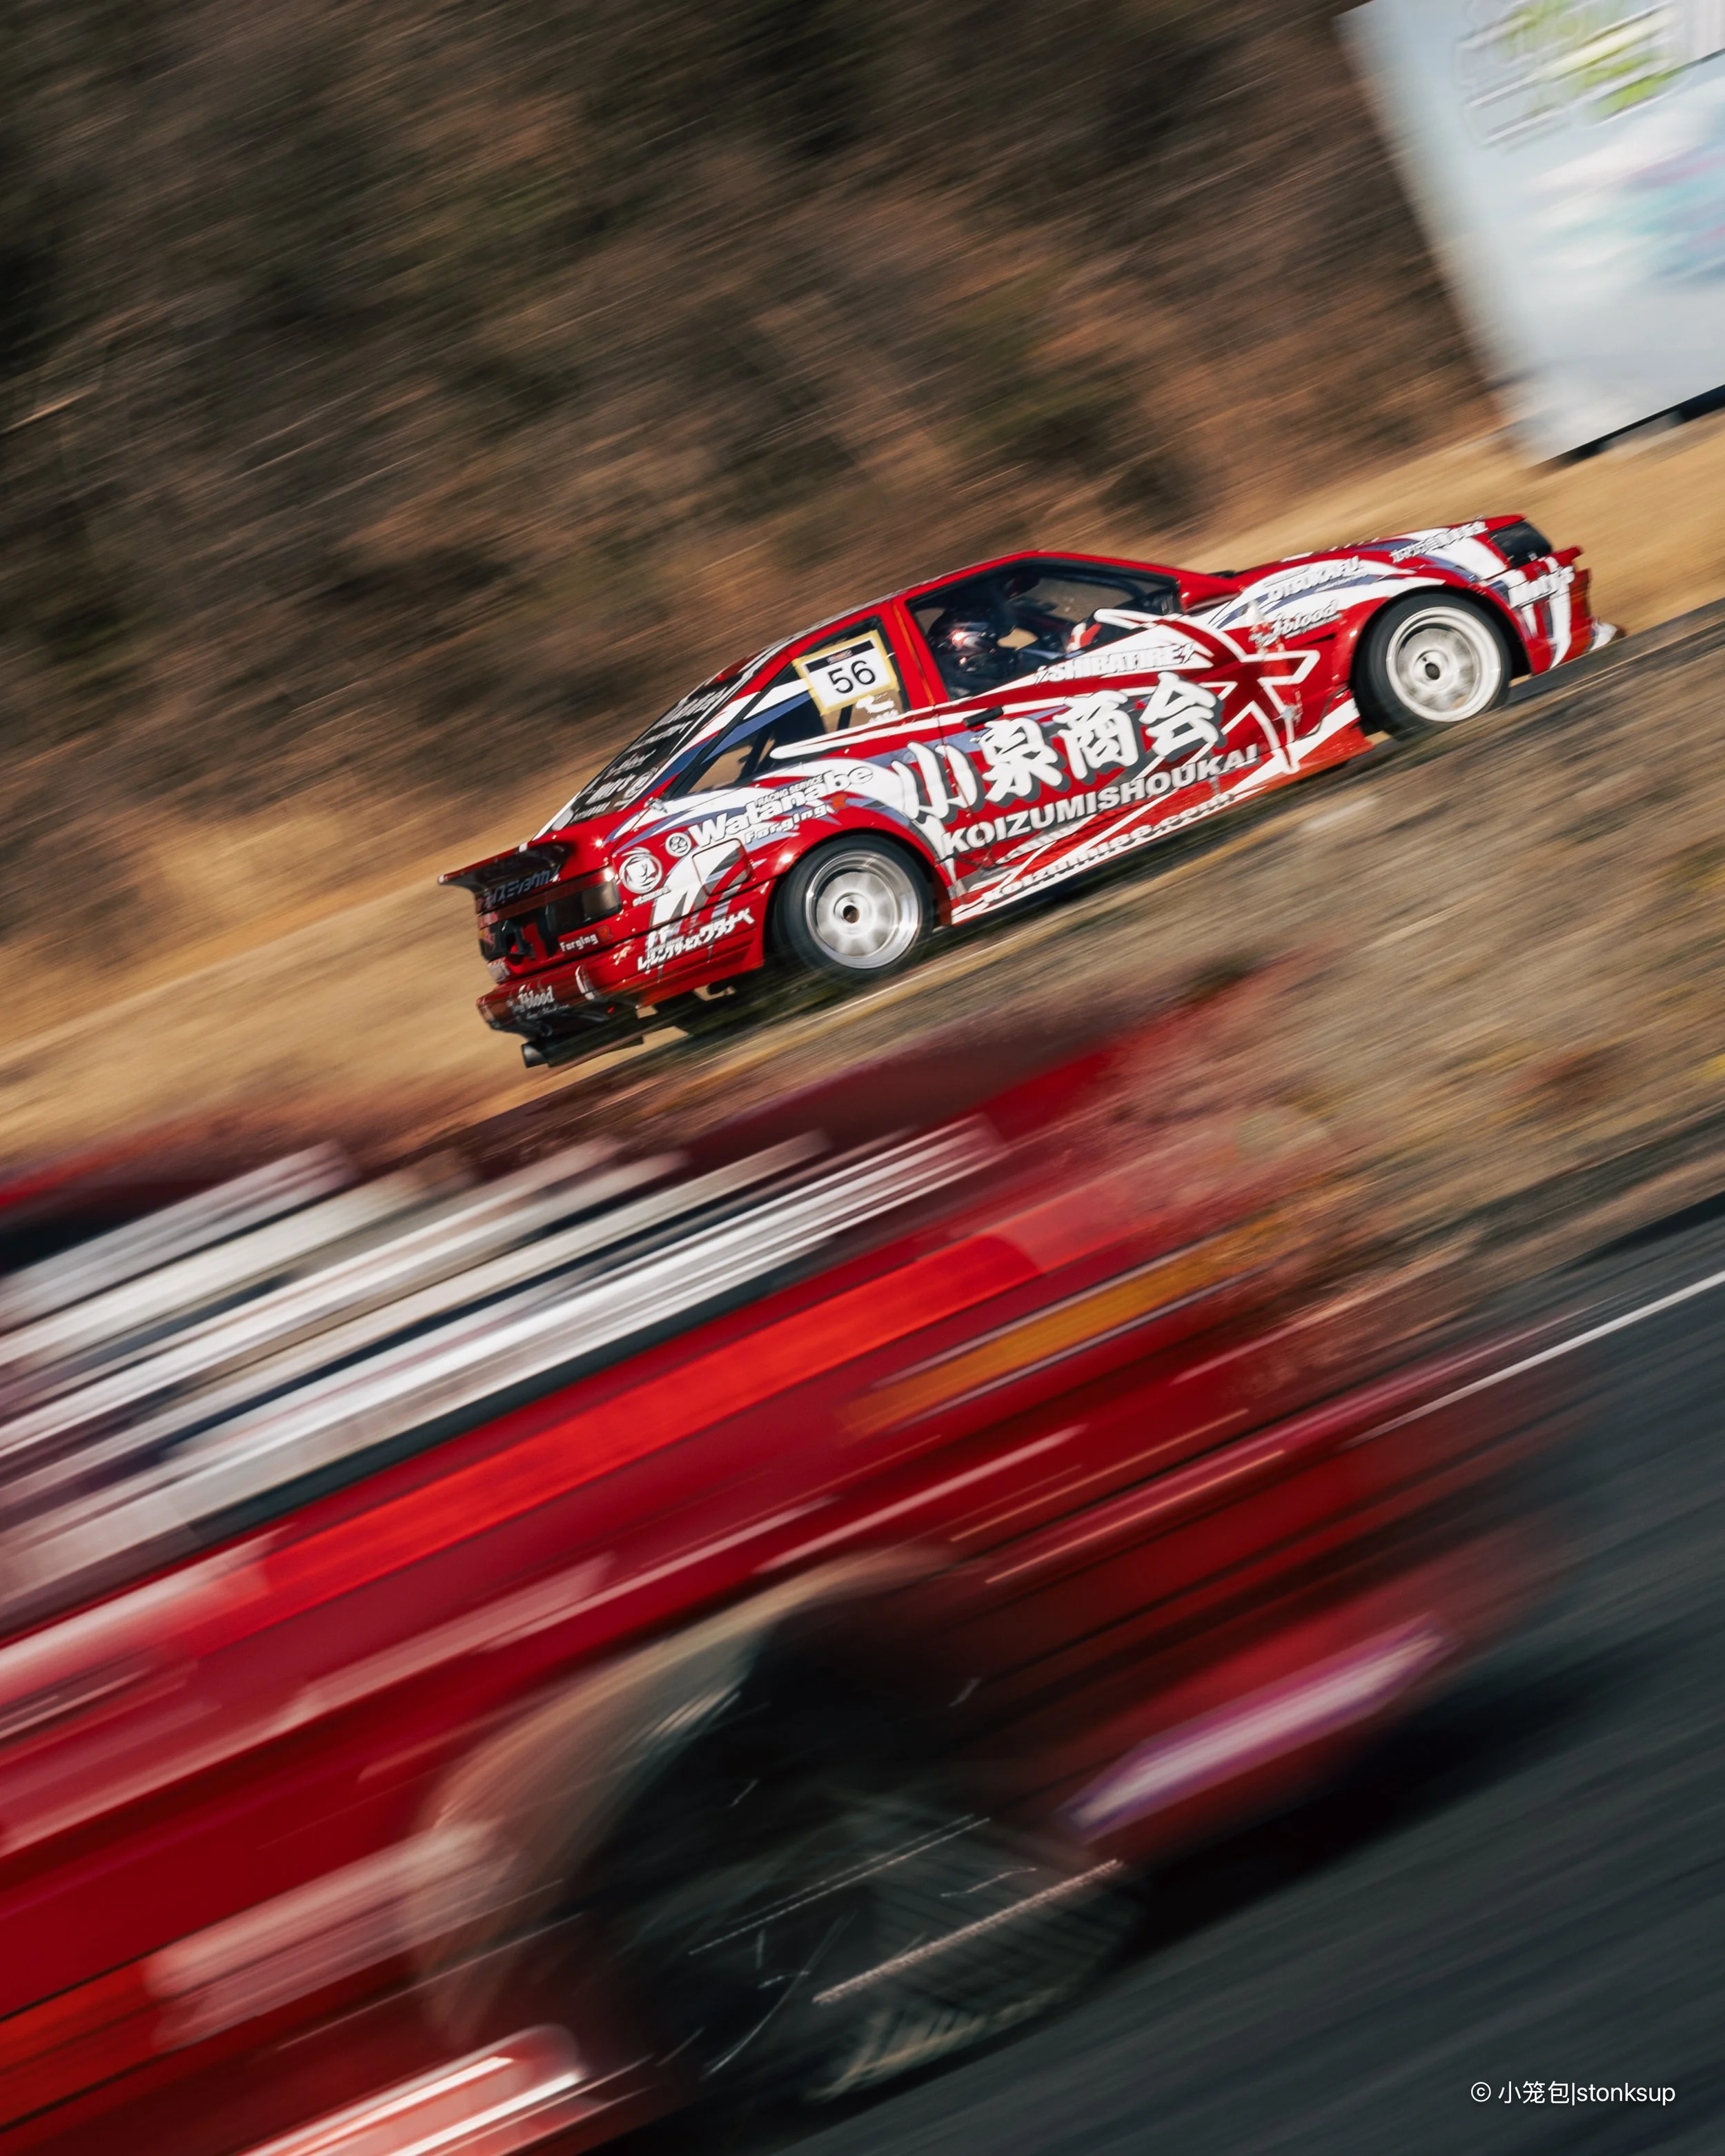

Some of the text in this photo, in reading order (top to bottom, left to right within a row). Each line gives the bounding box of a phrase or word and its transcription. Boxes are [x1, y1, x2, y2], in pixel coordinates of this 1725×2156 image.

[827, 660, 876, 693] 56
[1047, 644, 1183, 682] SHIBATIRE
[891, 671, 1220, 820] 小泉商会
[789, 775, 824, 798] SERVICE
[940, 744, 1259, 857] KOIZUMISHOUKAI
[688, 766, 874, 848] Watanabe
[745, 804, 827, 844] Forging
[560, 933, 599, 951] Forging
